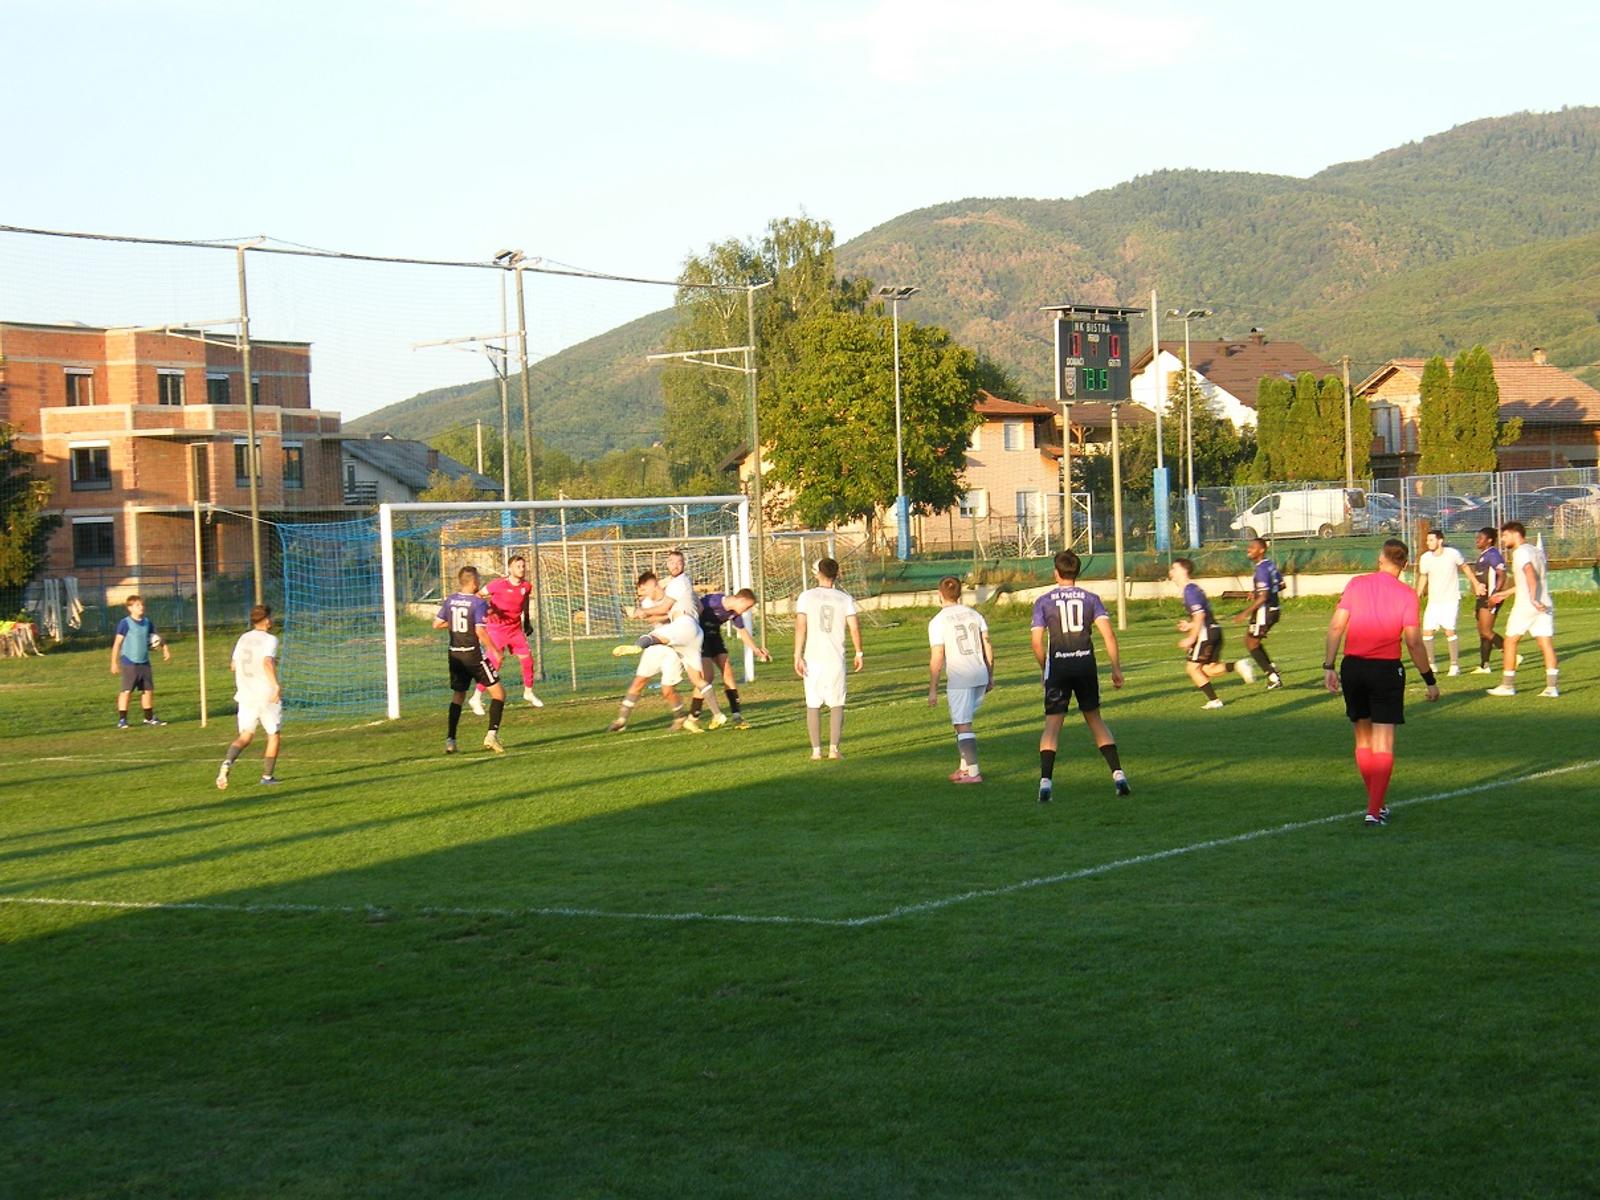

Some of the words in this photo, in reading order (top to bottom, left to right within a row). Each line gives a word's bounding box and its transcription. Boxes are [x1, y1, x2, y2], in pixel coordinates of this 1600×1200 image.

[1086, 323, 1111, 333] BISTRA
[450, 606, 469, 633] 16
[1056, 599, 1084, 634] 10
[954, 622, 980, 656] 21
[241, 649, 255, 678] 2
